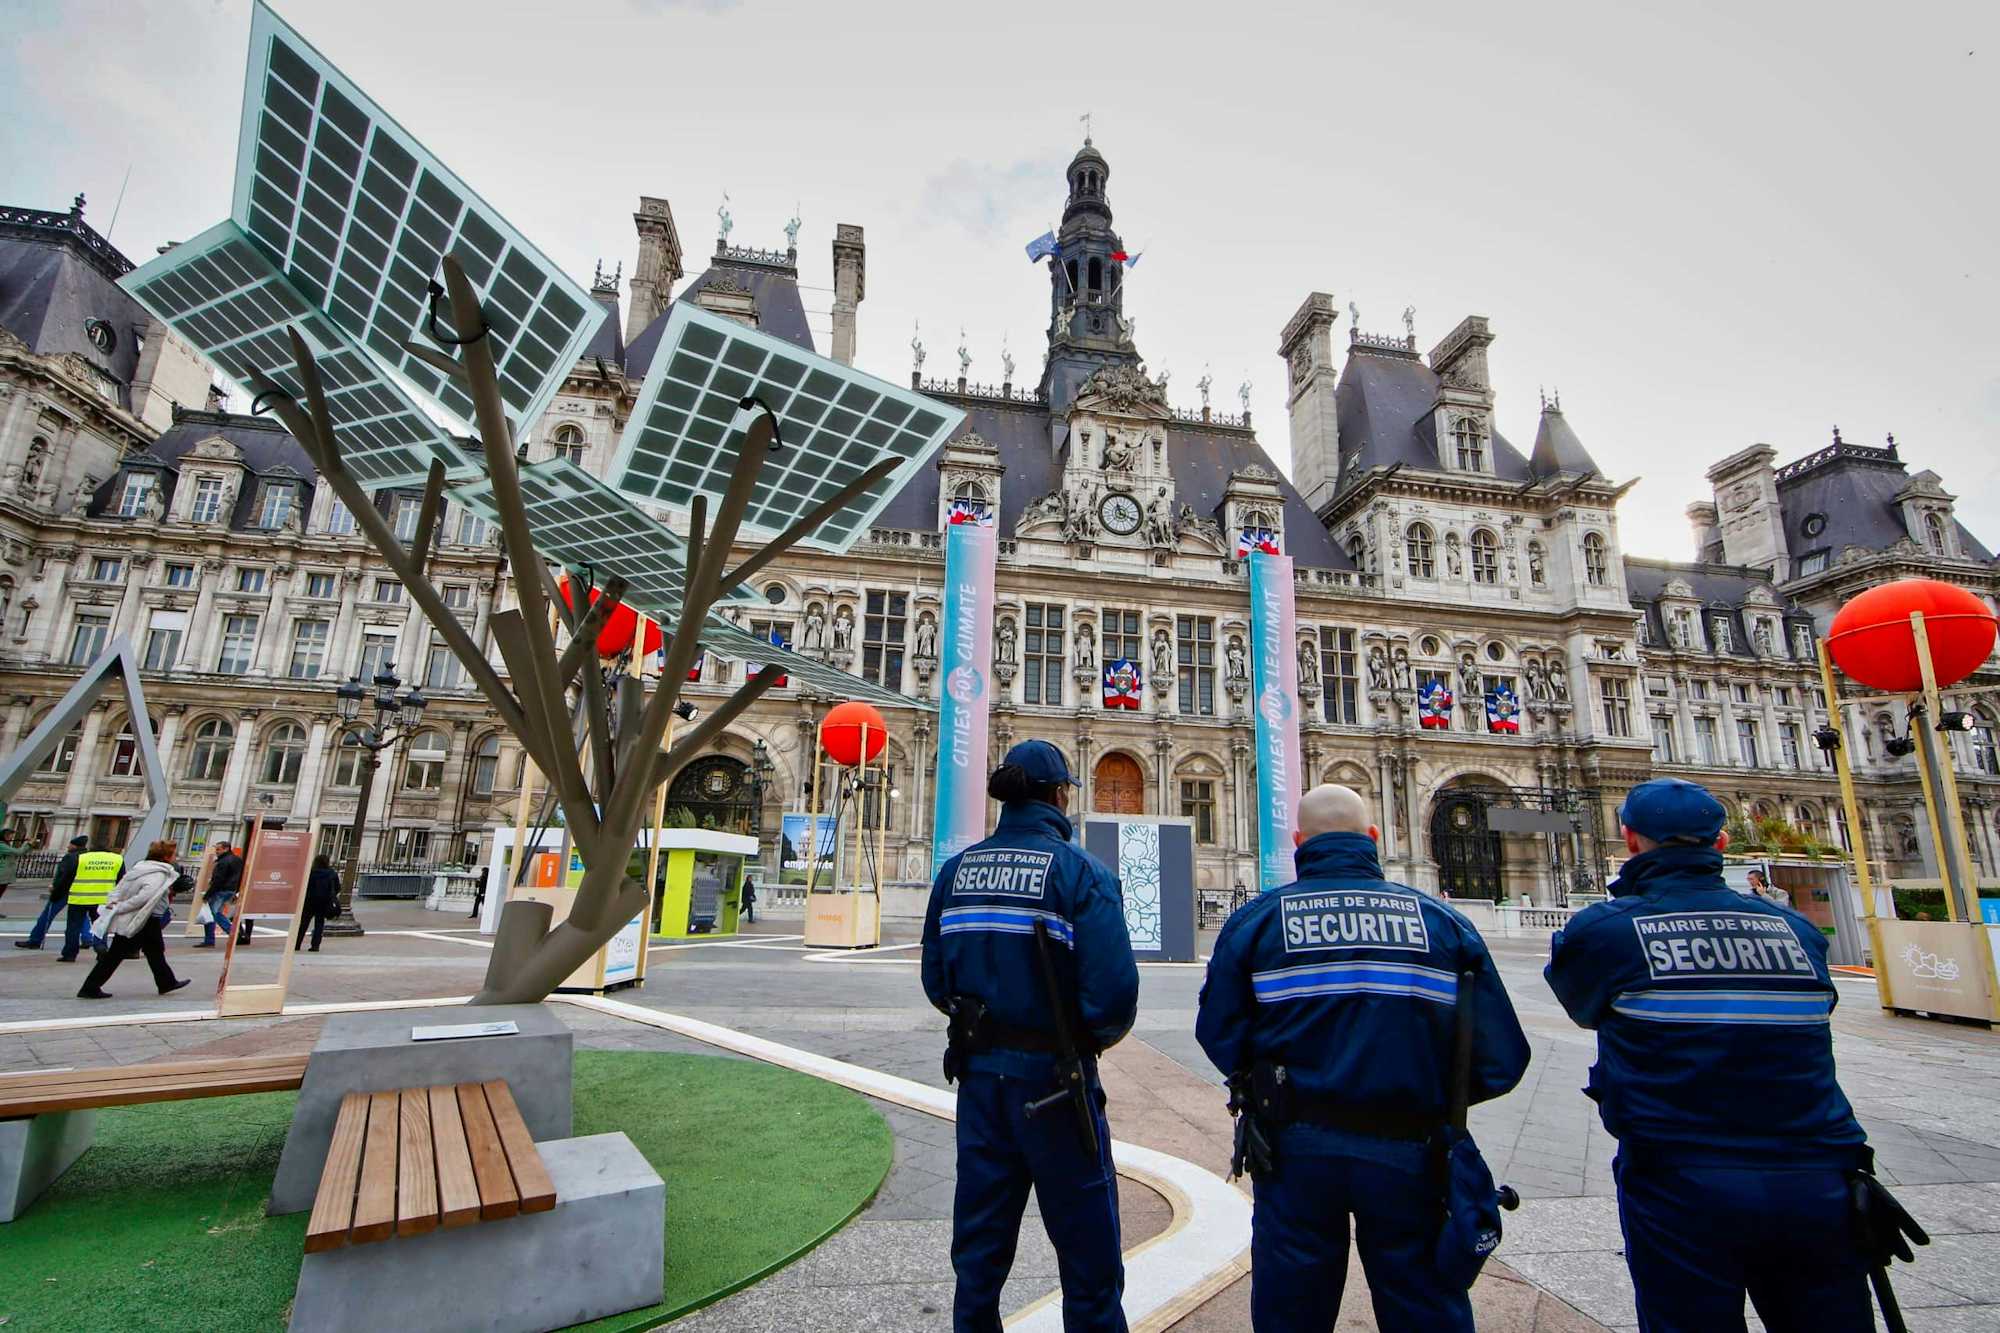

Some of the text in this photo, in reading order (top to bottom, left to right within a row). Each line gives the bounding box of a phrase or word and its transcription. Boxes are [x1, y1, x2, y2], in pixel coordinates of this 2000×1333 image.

[1264, 587, 1281, 656] CLIMAT
[953, 583, 976, 768] CITIES FOR CLIMATE
[1265, 656, 1281, 679] LE
[1265, 683, 1283, 731] POUR
[1269, 735, 1288, 792] VILLES
[1271, 797, 1288, 830] LES
[964, 853, 1048, 865] MAIRIE DE PARIS
[955, 866, 1044, 893] SECURITE
[1285, 896, 1416, 912] MAIRIE DE PARIS
[1287, 912, 1424, 945] SECURITE
[1639, 918, 1789, 934] MAIRIE DE PARIS
[1649, 936, 1811, 971] SECURITE
